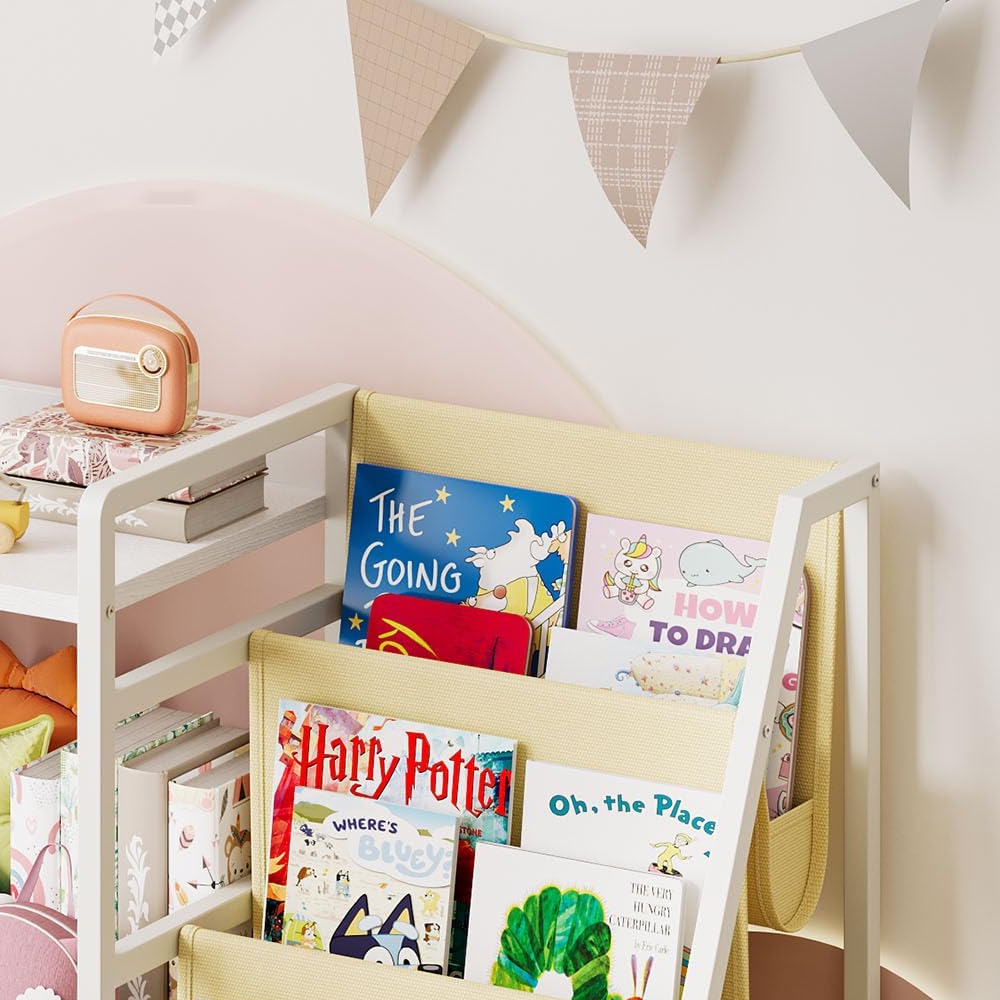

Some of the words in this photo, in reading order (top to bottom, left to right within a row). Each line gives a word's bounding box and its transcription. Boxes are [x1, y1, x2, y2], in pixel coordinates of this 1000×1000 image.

[369, 488, 433, 537] THE
[360, 541, 462, 594] GOING
[673, 592, 759, 628] HOW
[650, 620, 688, 646] TO
[292, 724, 401, 801] Harry
[405, 731, 513, 818] Potter
[333, 818, 398, 834] WHERE'S
[549, 794, 599, 817] Oh,
[603, 794, 646, 816] the
[654, 793, 717, 836] Place
[631, 882, 650, 897] THE
[650, 885, 673, 900] VERY
[609, 914, 671, 936] CATERPILLAR
[633, 901, 671, 918] HUNGRY
